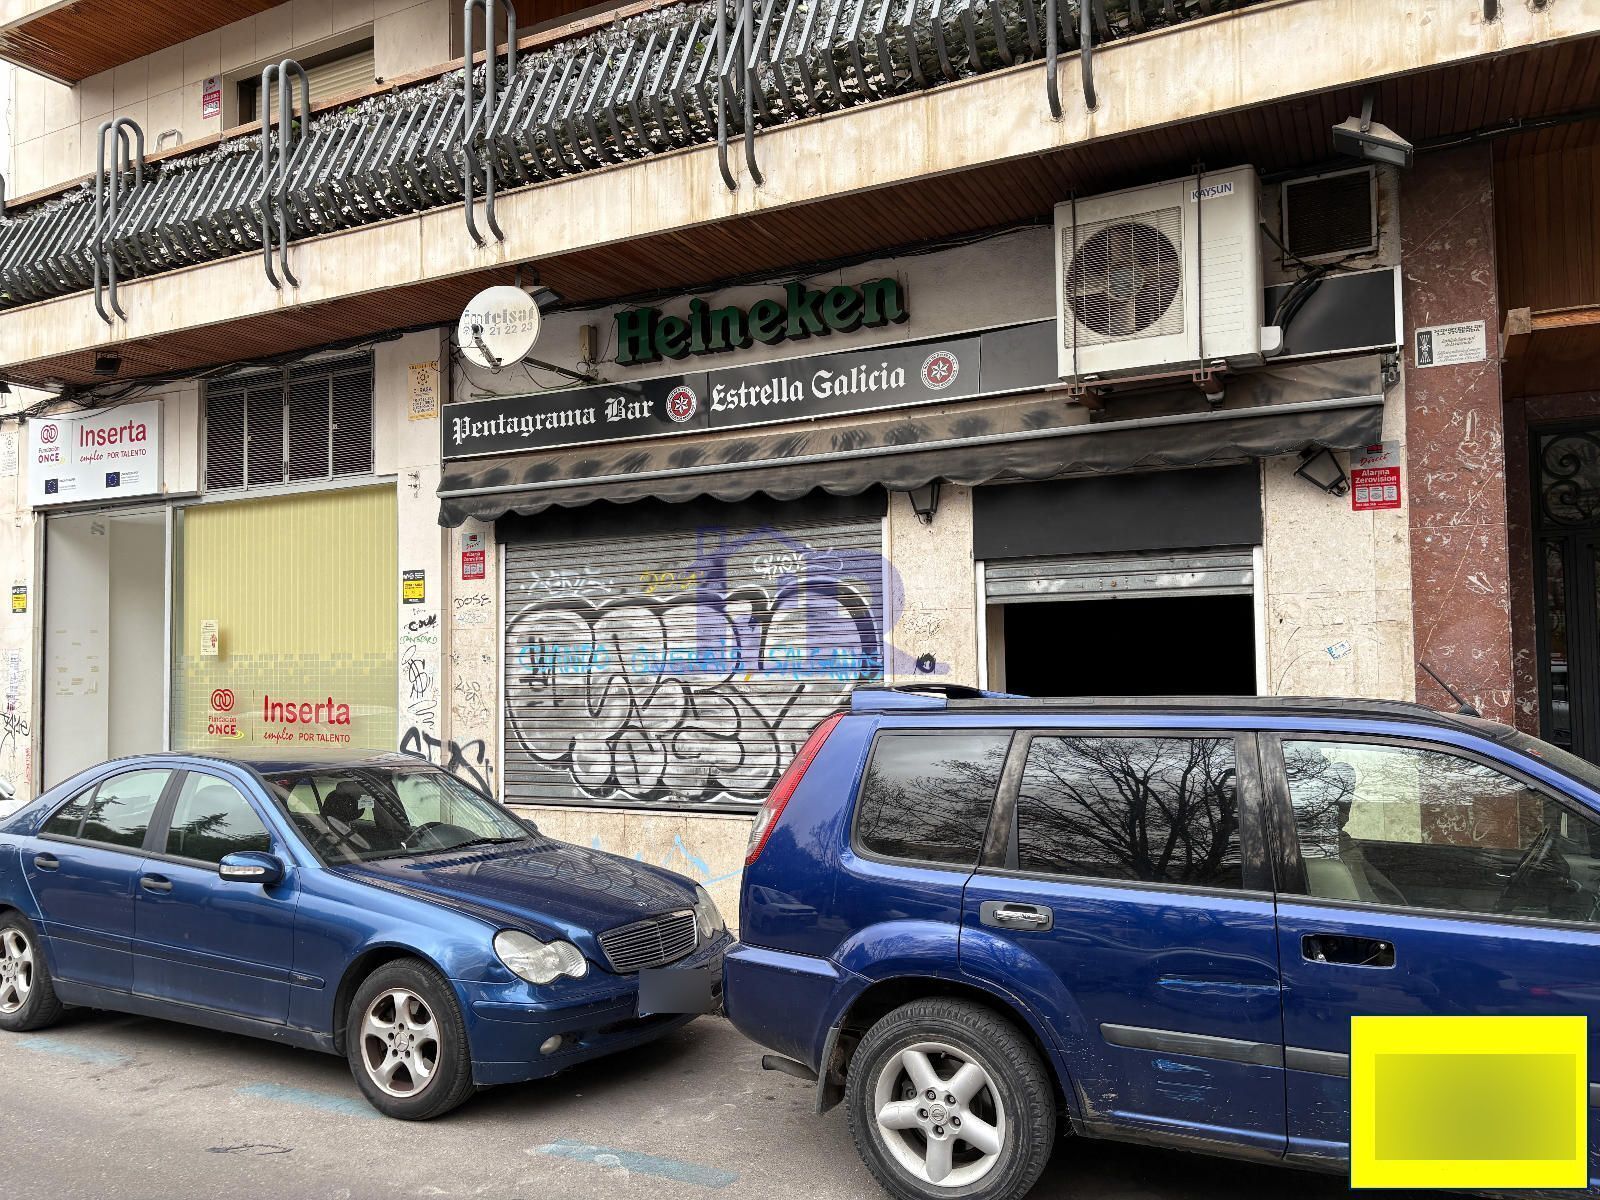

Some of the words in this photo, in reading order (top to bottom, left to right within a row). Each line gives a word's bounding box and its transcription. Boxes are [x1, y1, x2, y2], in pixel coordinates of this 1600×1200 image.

[1192, 183, 1232, 199] KAYSUN
[505, 325, 517, 334] 22
[521, 322, 533, 332] 23
[614, 278, 908, 366] Heineken
[710, 376, 805, 412] Estrella
[811, 362, 906, 399] Galicia
[452, 406, 597, 446] Pentagrama
[605, 396, 654, 422] Bar
[79, 420, 147, 448] Inserta
[38, 453, 60, 464] ONCE
[79, 450, 104, 465] empleo
[107, 451, 119, 459] POR
[121, 448, 147, 458] TALENTO
[1355, 475, 1397, 484] Zerovision
[263, 694, 351, 725] Inserta
[208, 724, 236, 735] ONCE
[263, 726, 294, 744] empleo
[299, 732, 314, 741] POR
[317, 733, 350, 743] TALENTO
